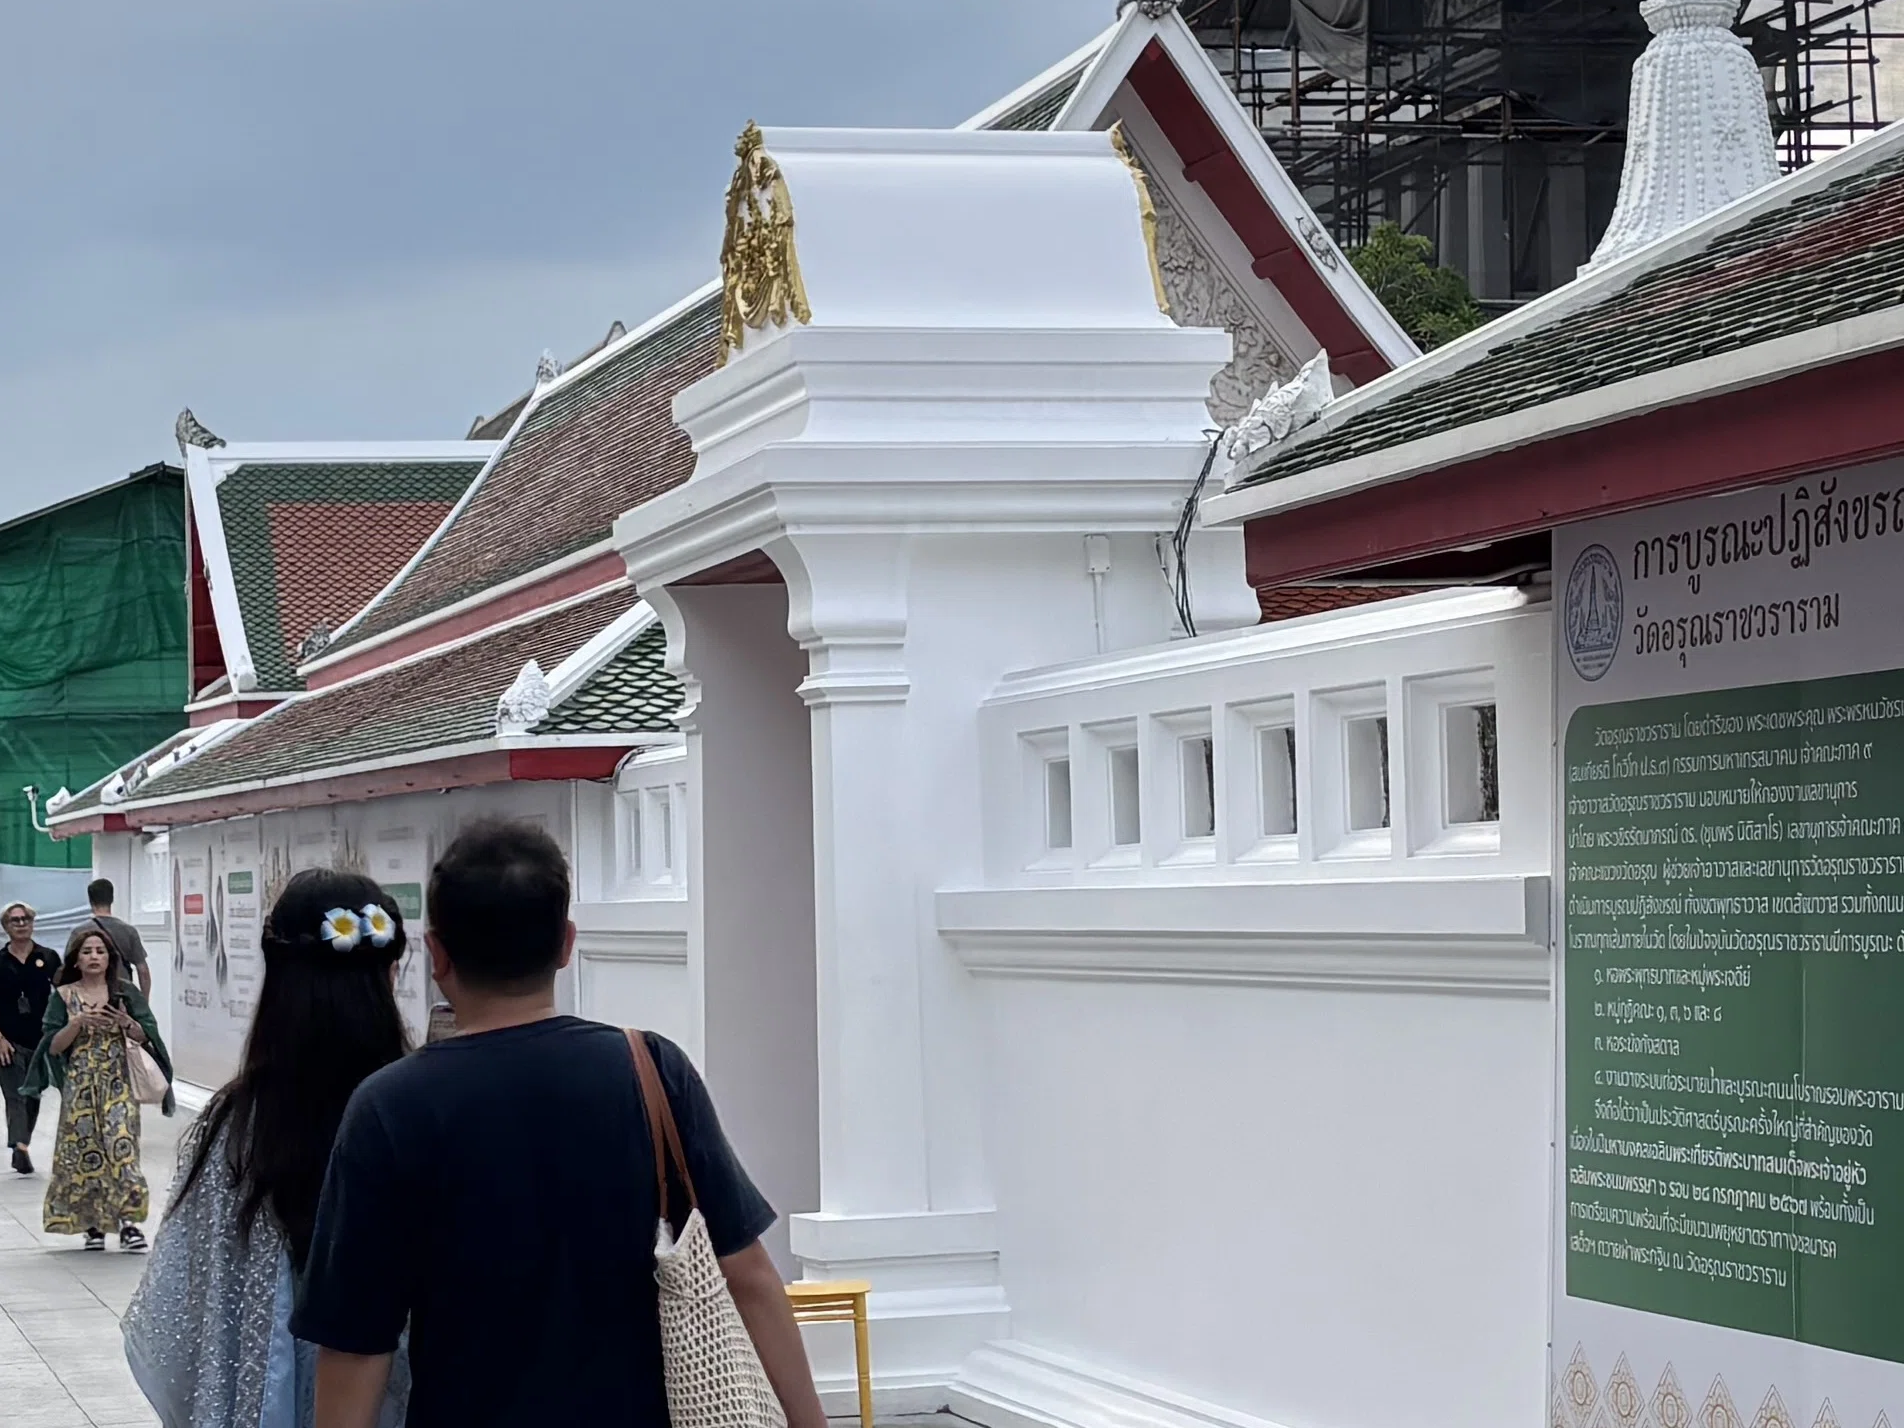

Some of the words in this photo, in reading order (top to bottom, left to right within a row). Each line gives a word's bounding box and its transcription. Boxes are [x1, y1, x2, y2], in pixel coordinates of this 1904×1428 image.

[1633, 592, 1841, 668] วัดอรุณราชวราราม
[1595, 723, 1681, 750] วัดอรุณราชวราราม
[1684, 712, 1743, 737] โดยดำริของ
[1747, 708, 1823, 732] พระเดชพระคุณ
[1673, 748, 1796, 773] กรรมการมหาเถรสมาคม
[1801, 741, 1859, 764] เจ้าคณะภาค
[1864, 742, 1873, 759] ๙
[1568, 792, 1695, 817] เจ้าอาวาสวัดอรุณราชวราราม
[1699, 778, 1857, 806] มอบหมายให้กองงานเลขานุการ
[1682, 828, 1697, 844] ดร.
[1701, 824, 1733, 848] (ชุมพร
[1788, 814, 1900, 845] เลขานุการเจ้าคณะภาค
[1842, 884, 1904, 913] รวมทั้งถนน
[1684, 1006, 1691, 1020] ๖
[1695, 1006, 1710, 1021] และ
[1669, 1182, 1689, 1201] รอบ
[1713, 1187, 1765, 1211] กรกฎาคม
[1770, 1193, 1807, 1215] ๒๕๖๗
[1811, 1191, 1874, 1225] พร้อมทั้งเป็น
[1673, 1253, 1683, 1269] ณ
[1687, 1251, 1786, 1286] วัดอรุณราชวราราม
